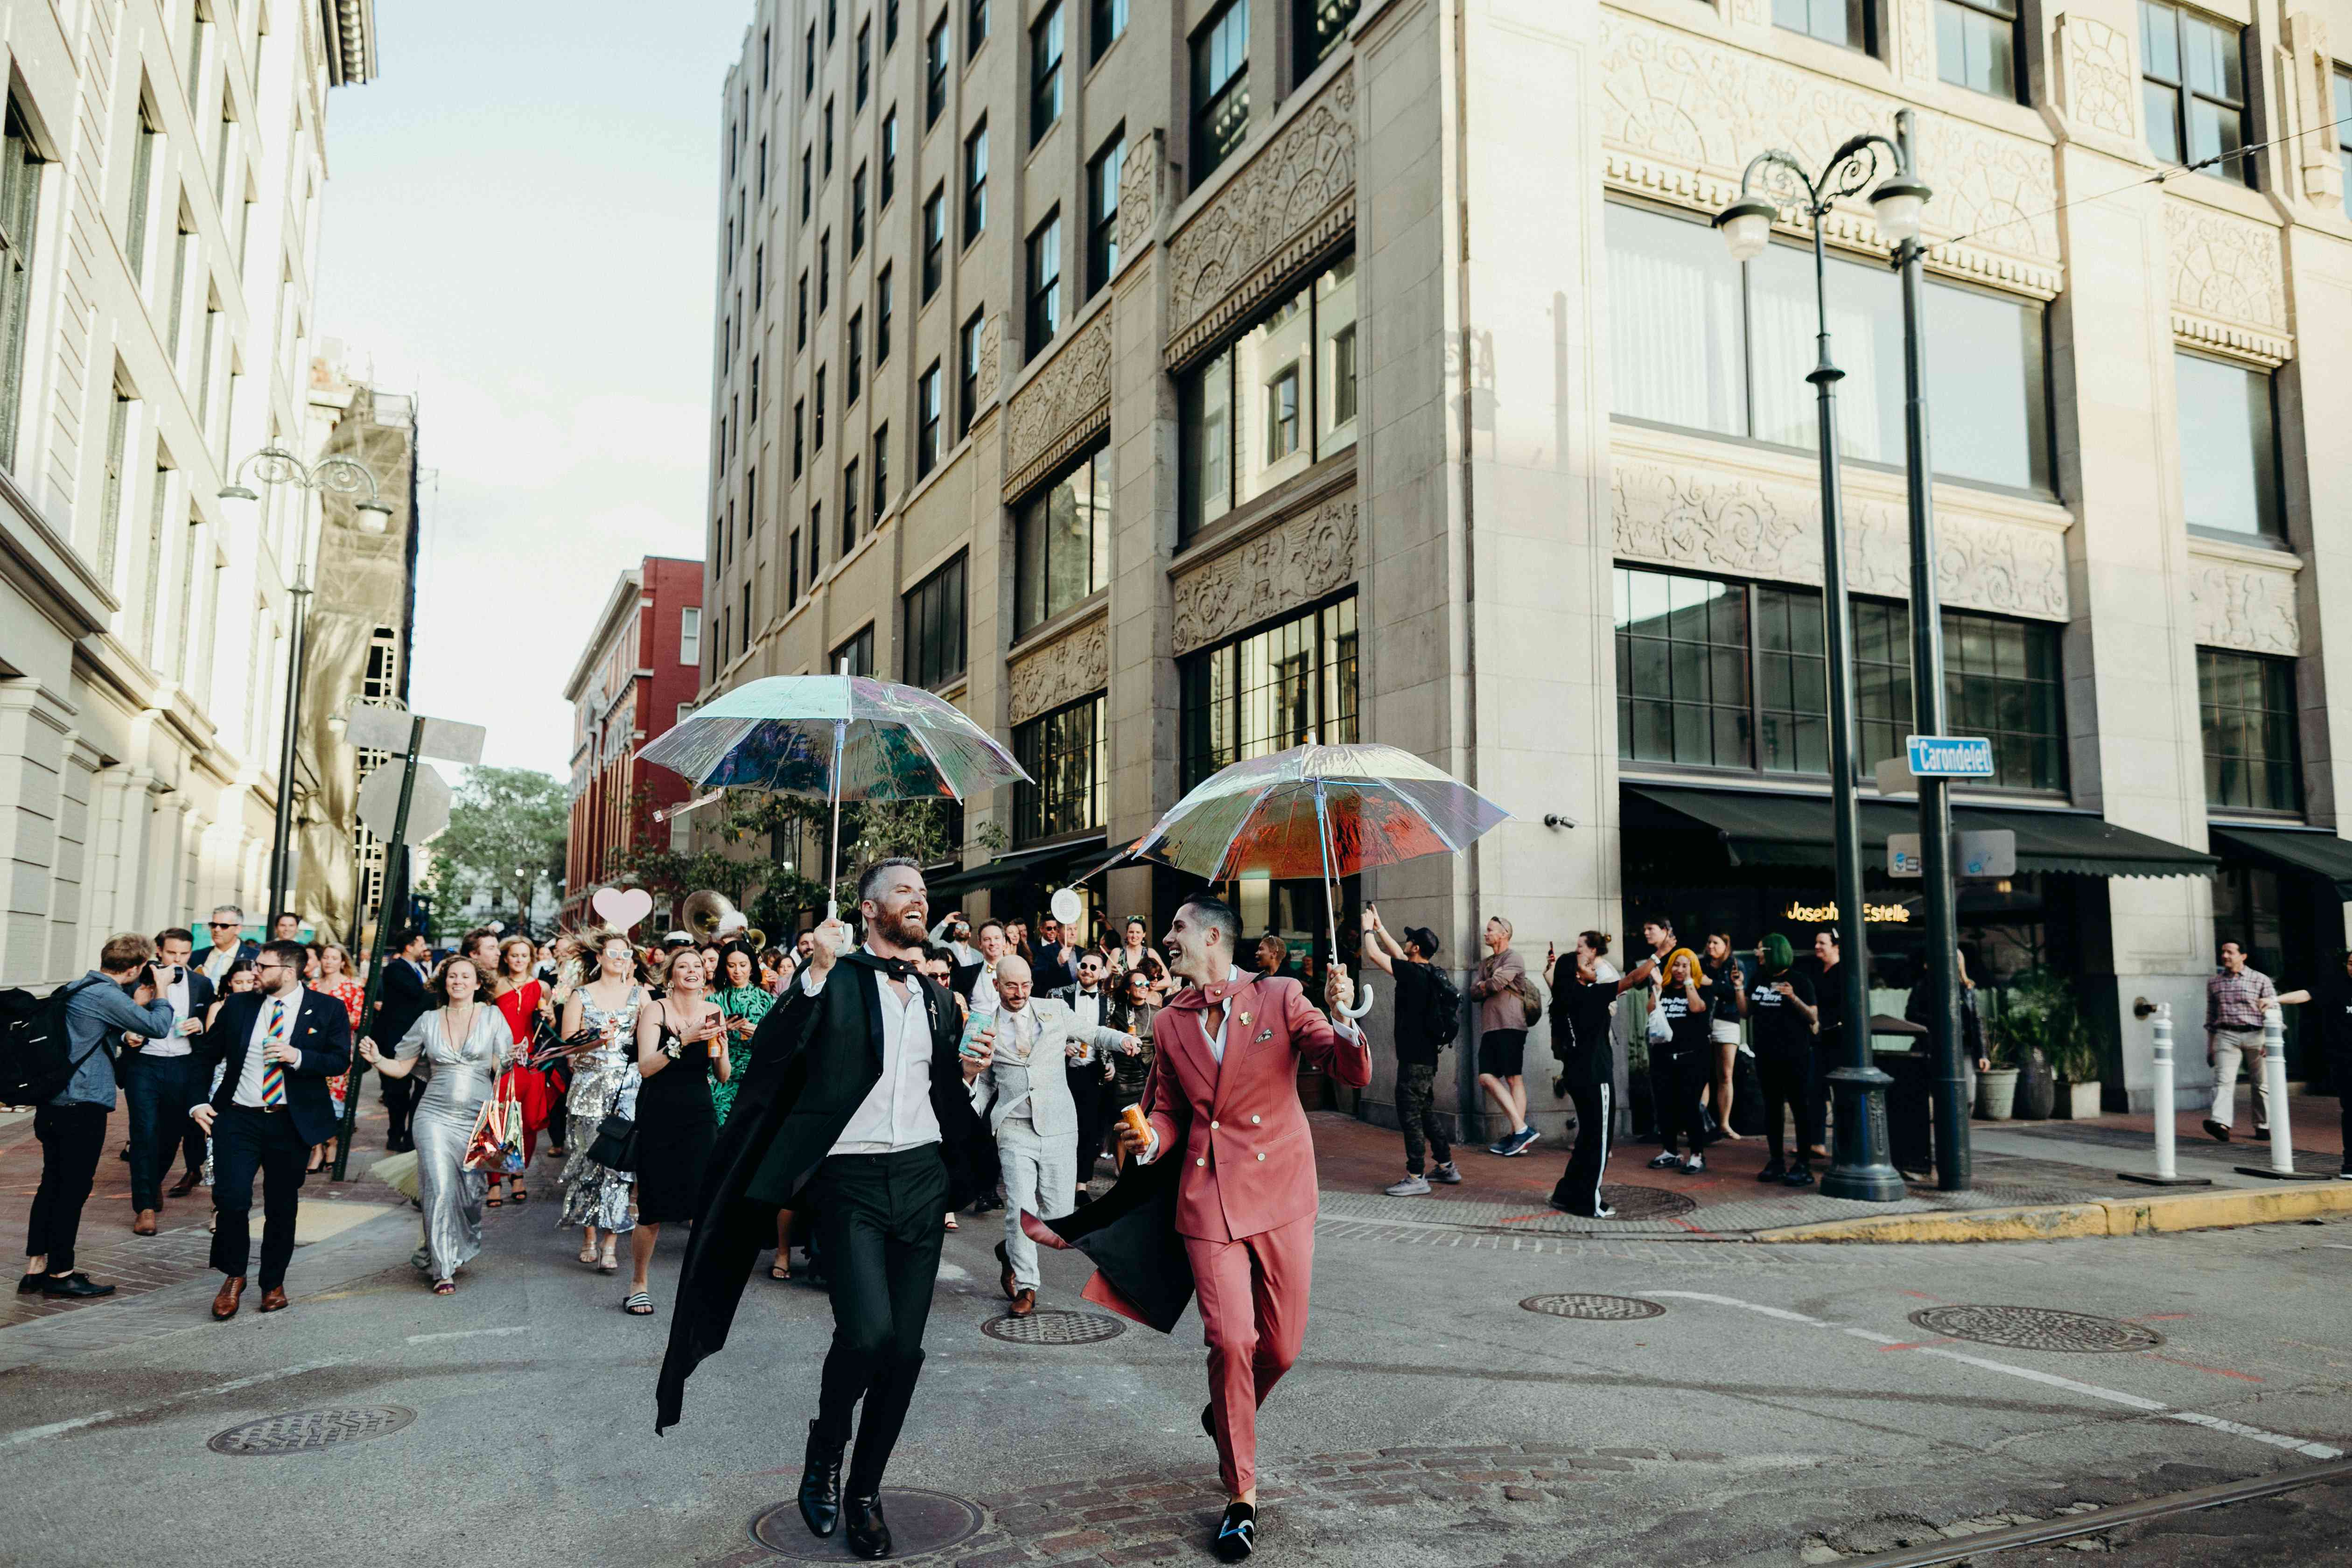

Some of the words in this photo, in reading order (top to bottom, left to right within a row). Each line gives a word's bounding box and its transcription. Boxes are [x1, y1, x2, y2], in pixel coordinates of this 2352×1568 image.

[1919, 741, 1989, 771] Carondelet
[1787, 901, 1839, 923] Joseph
[1863, 903, 1910, 922] Estelle
[1040, 1316, 1067, 1340] DRAIN
